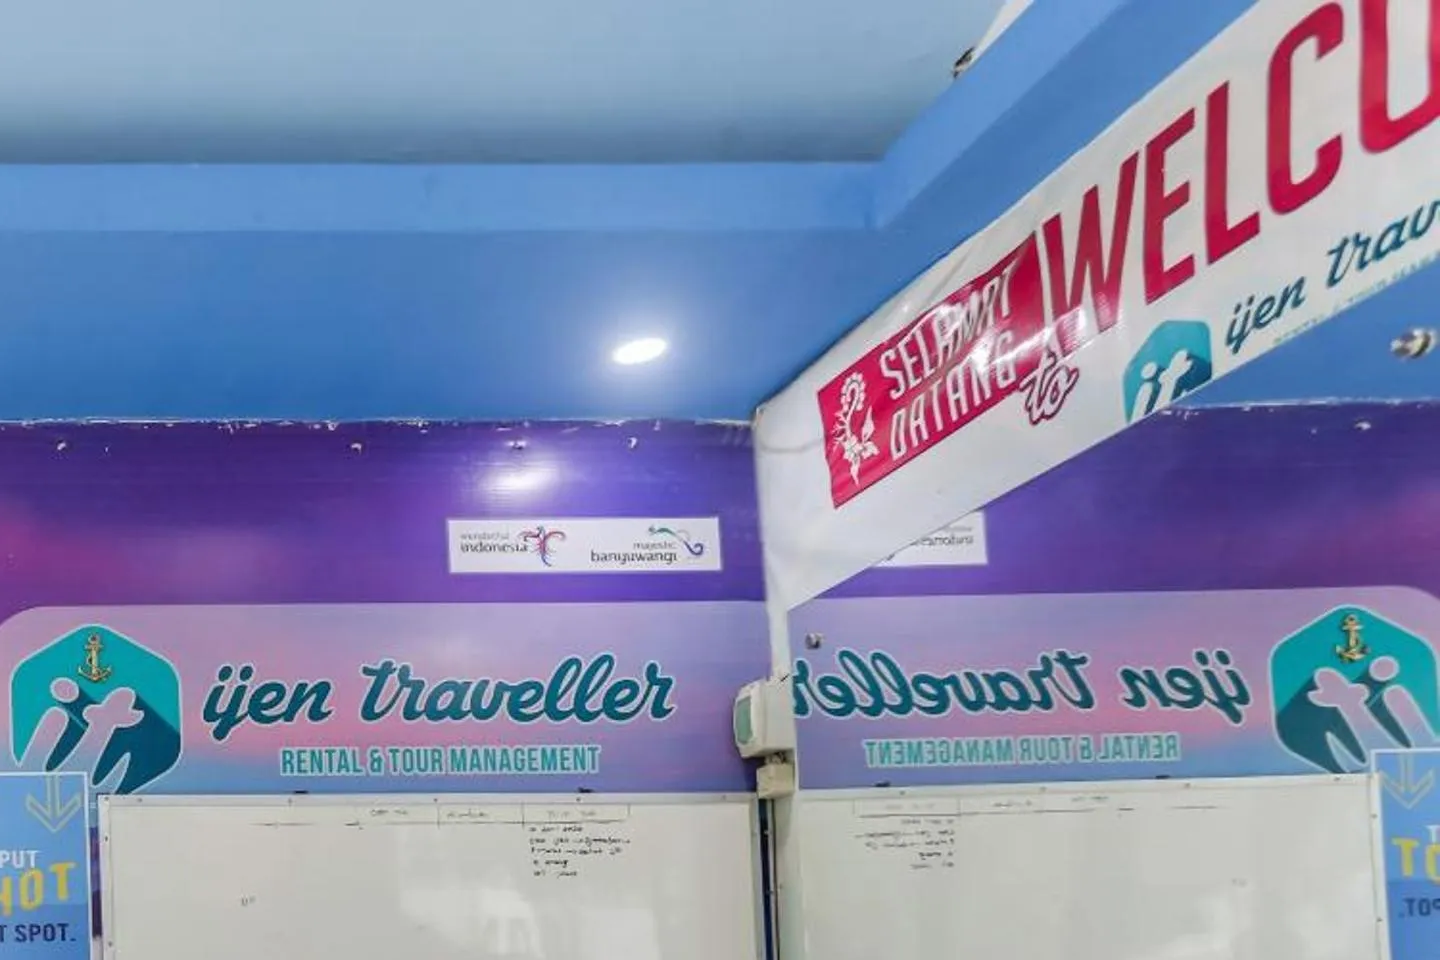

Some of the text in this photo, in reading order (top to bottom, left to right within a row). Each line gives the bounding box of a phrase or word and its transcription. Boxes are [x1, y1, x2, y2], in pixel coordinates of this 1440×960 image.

[880, 260, 1017, 400] SELAMAT
[1225, 277, 1305, 355] ijen
[890, 330, 1017, 461] DATANG
[1018, 348, 1080, 426] to
[460, 541, 528, 553] indonesia
[590, 549, 679, 565] banyuwangi
[202, 652, 675, 743] ijen traveller
[280, 745, 600, 776] RENTAL & TOUR MANAGEMENT
[14, 922, 77, 943] SPOT.
